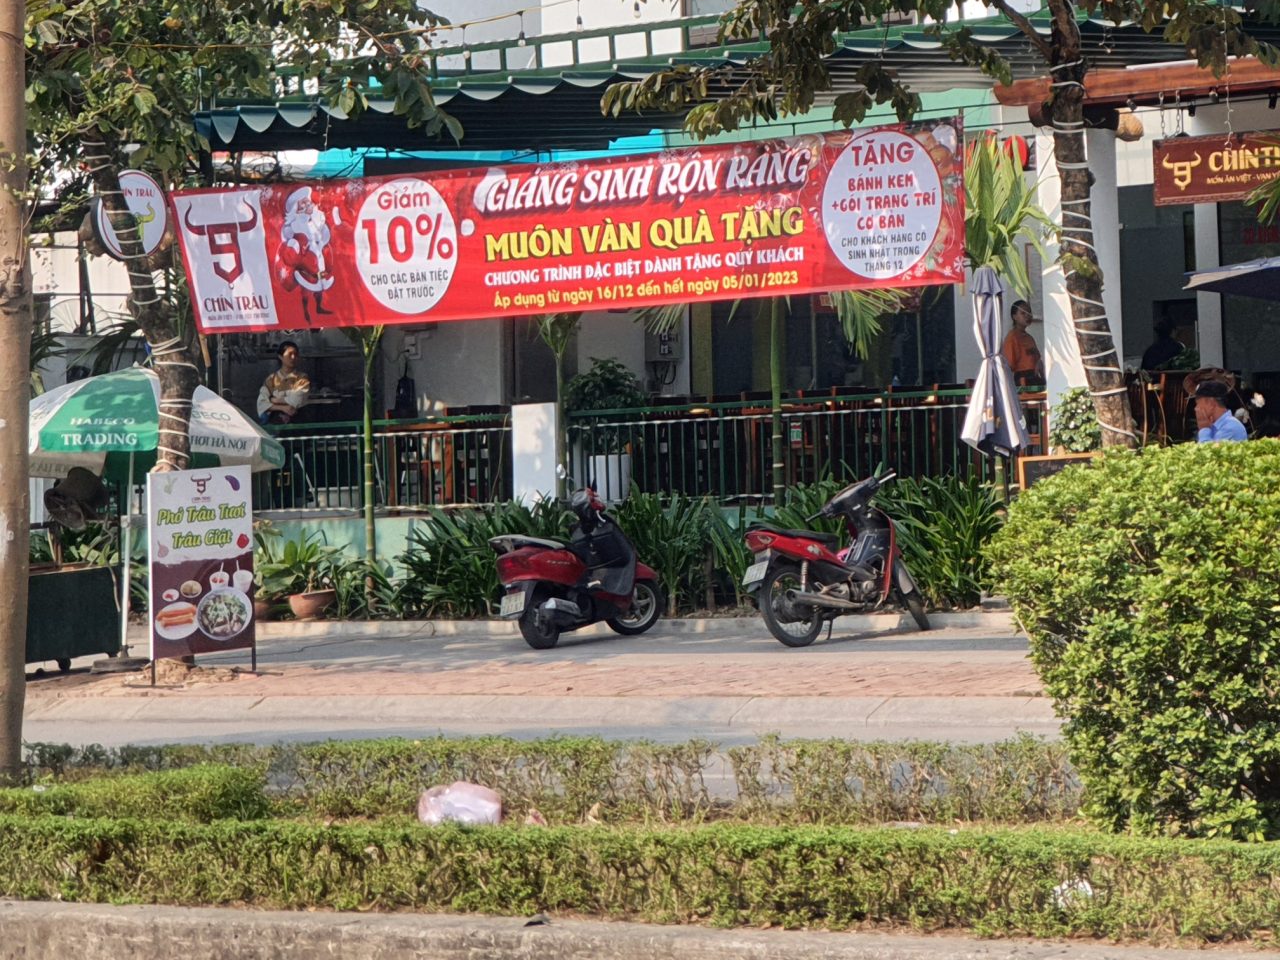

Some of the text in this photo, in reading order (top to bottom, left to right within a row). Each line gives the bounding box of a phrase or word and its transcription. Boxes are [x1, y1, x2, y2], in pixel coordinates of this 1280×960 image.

[851, 139, 915, 172] TẶNG
[1208, 144, 1260, 172] CHÍN
[485, 144, 812, 213] GIÁNG SINH RỘN RÀNG
[848, 173, 914, 192] BÁNH KEM
[377, 186, 431, 211] Giảm
[866, 195, 909, 210] TRANG
[914, 187, 936, 207] TRÍ
[857, 213, 874, 231] CƠ
[361, 212, 454, 265] 10%
[485, 204, 805, 263] MUÔN VÀN QUÀ TẶNG
[841, 236, 858, 247] CHO
[848, 249, 867, 260] SINH
[893, 245, 920, 257] TRONG
[484, 269, 540, 286] CHƯƠNG
[543, 263, 582, 282] TRÌNH
[585, 260, 611, 281] ĐẶC
[615, 258, 642, 279] BIỆT
[645, 254, 682, 274] DÀNH
[685, 252, 722, 272] TẶNG
[757, 245, 805, 265] KHÁCH
[894, 260, 903, 270] 12
[370, 274, 389, 286] CHO
[494, 270, 799, 309] Áp dụng từ ngày 16/12 đến hết ngày 05/01/2023
[204, 293, 269, 313] CHÍN TRÂU
[70, 417, 136, 426] HABECO
[192, 410, 231, 421] BECO
[61, 432, 137, 446] TRADING
[157, 506, 184, 526] Phở
[186, 505, 216, 523] Trâu
[172, 531, 202, 549] Trâu
